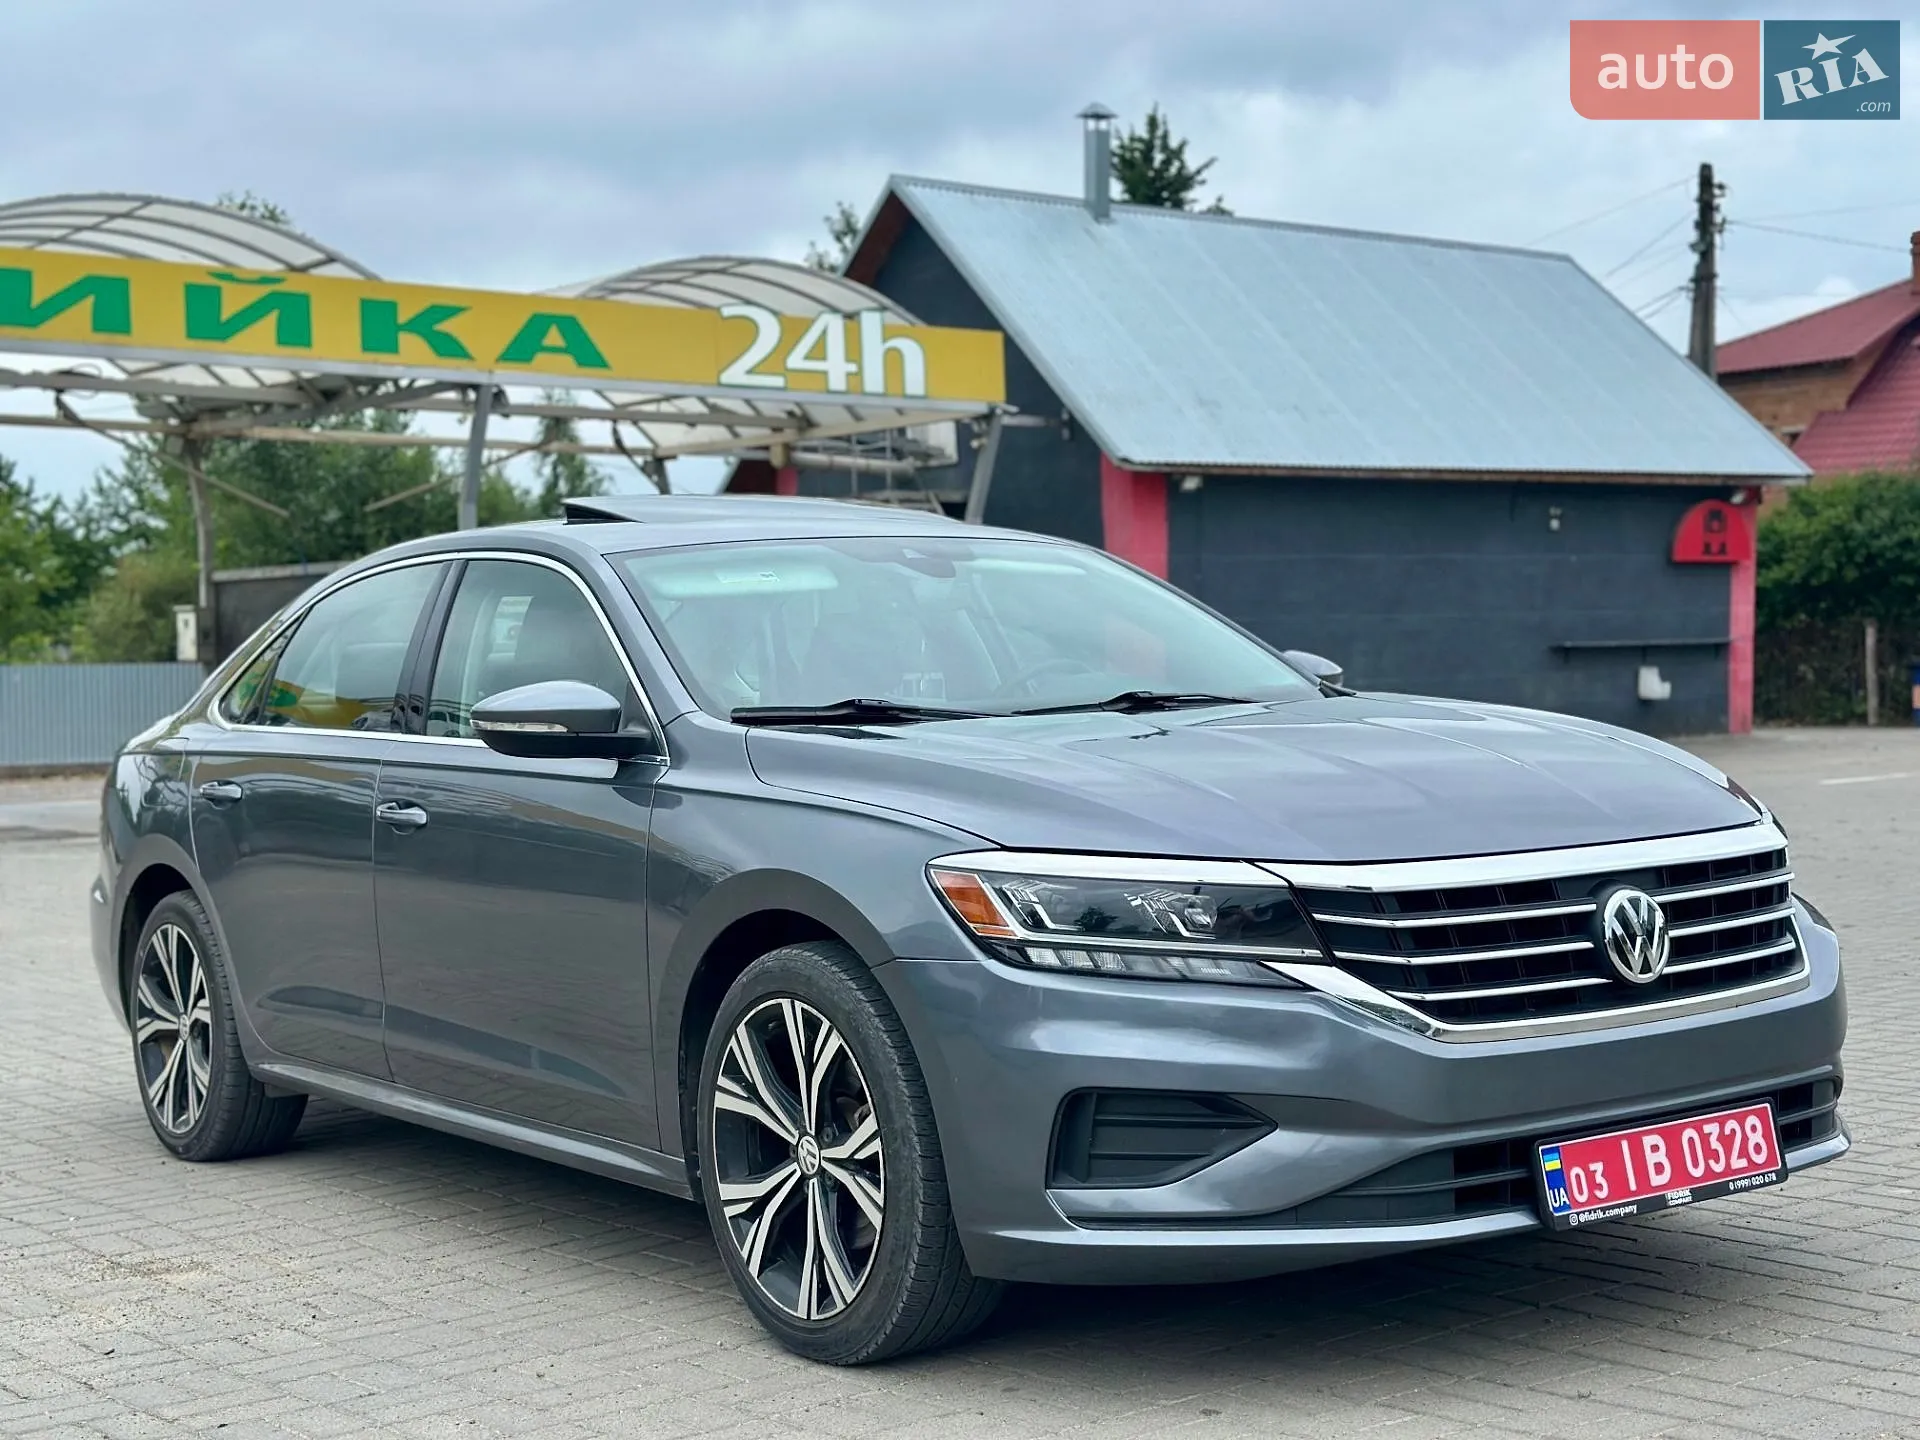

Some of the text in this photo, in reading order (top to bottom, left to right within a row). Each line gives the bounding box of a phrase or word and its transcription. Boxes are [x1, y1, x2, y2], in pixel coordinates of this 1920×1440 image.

[718, 302, 927, 398] 24h
[1549, 1187, 1570, 1208] UA
[1570, 1115, 1768, 1203] 03 IB 0328
